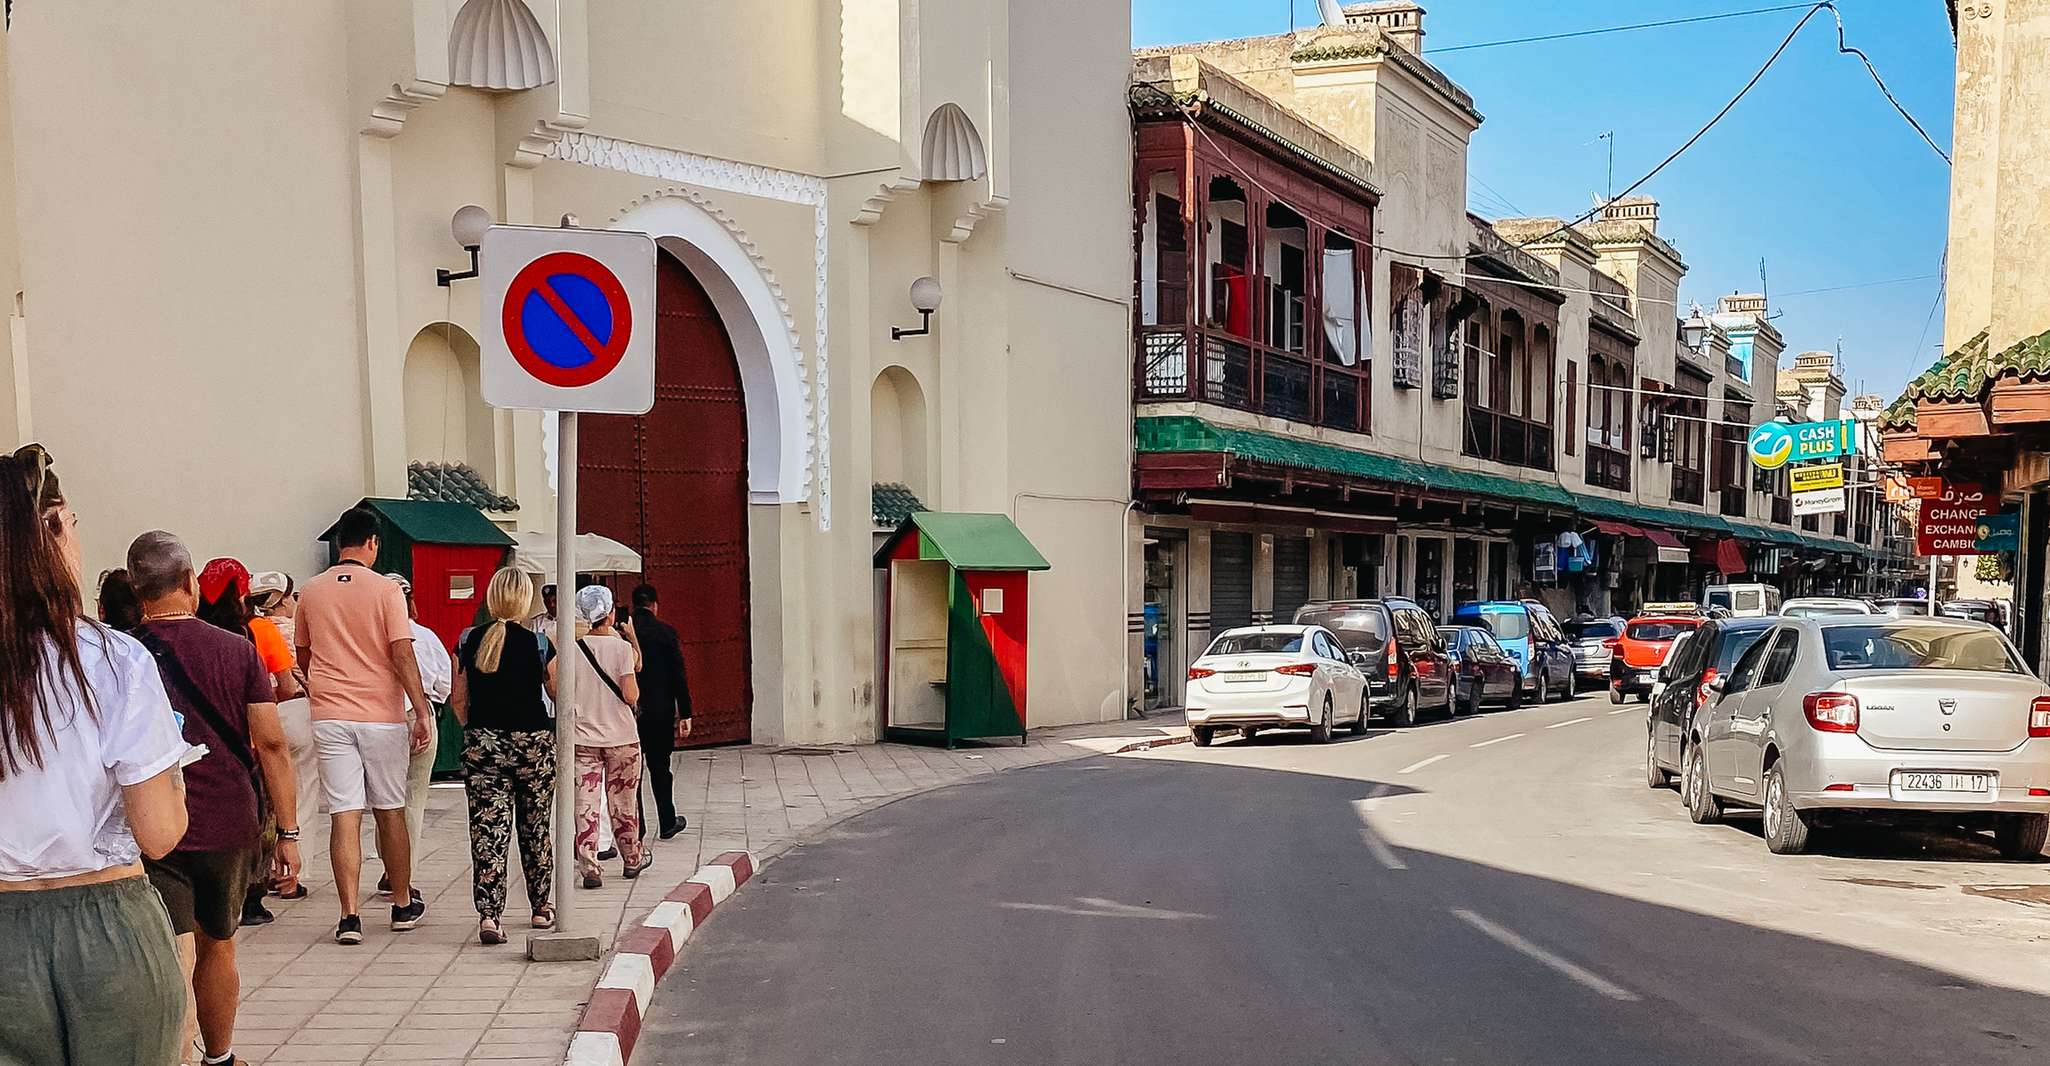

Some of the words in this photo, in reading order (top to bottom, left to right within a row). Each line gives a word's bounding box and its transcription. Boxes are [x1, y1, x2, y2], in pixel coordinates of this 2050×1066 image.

[1799, 426, 1834, 441] CASH
[1800, 440, 1834, 455] PLUS
[1925, 525, 1976, 535] EXCHAN
[1908, 774, 1942, 789] 22436
[1971, 775, 1983, 790] 17
